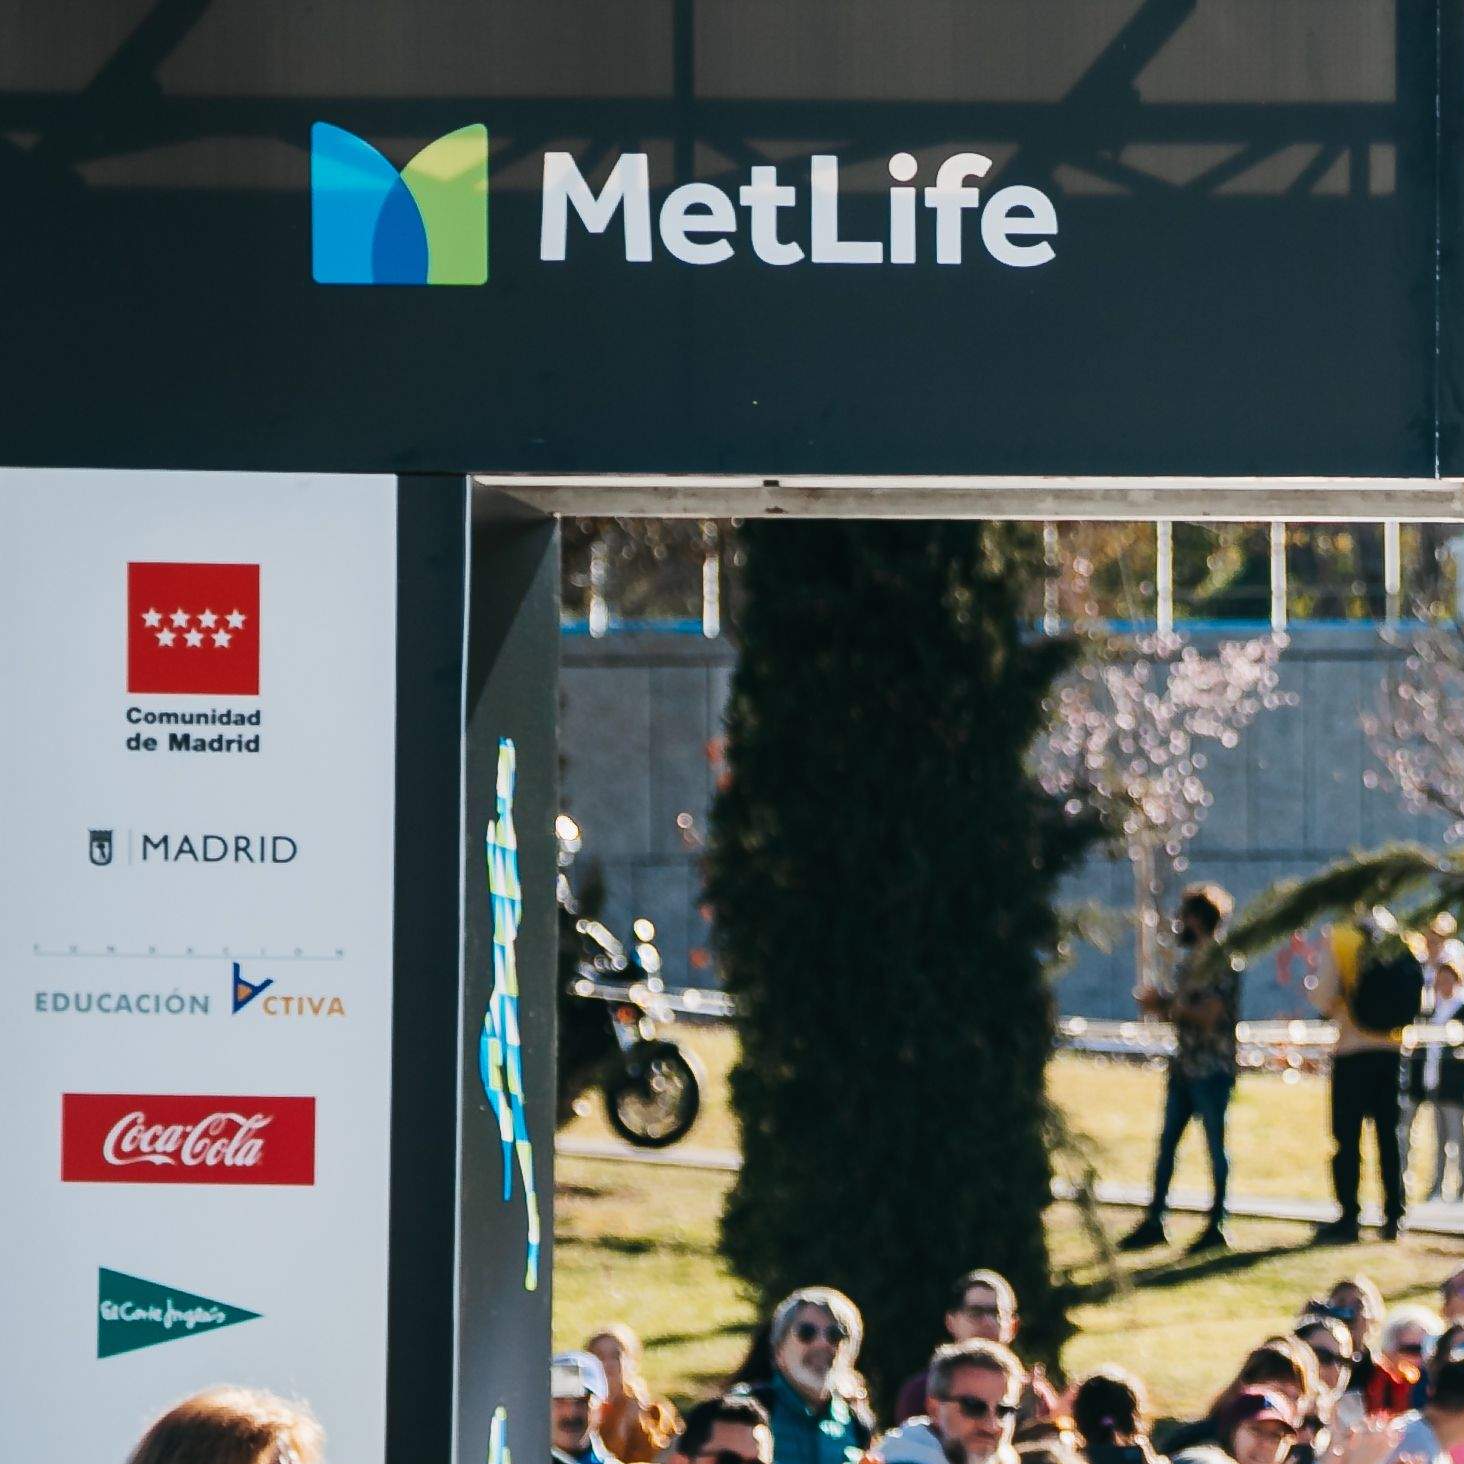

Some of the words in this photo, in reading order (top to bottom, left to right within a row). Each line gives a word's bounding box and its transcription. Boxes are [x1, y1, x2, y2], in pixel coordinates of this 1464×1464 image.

[538, 150, 1059, 267] MetLife
[126, 706, 262, 727] Comunidad
[125, 733, 158, 753] de
[168, 732, 261, 754] Madrid
[141, 834, 298, 864] MADRID
[34, 987, 210, 1016] EDUCACIÓN
